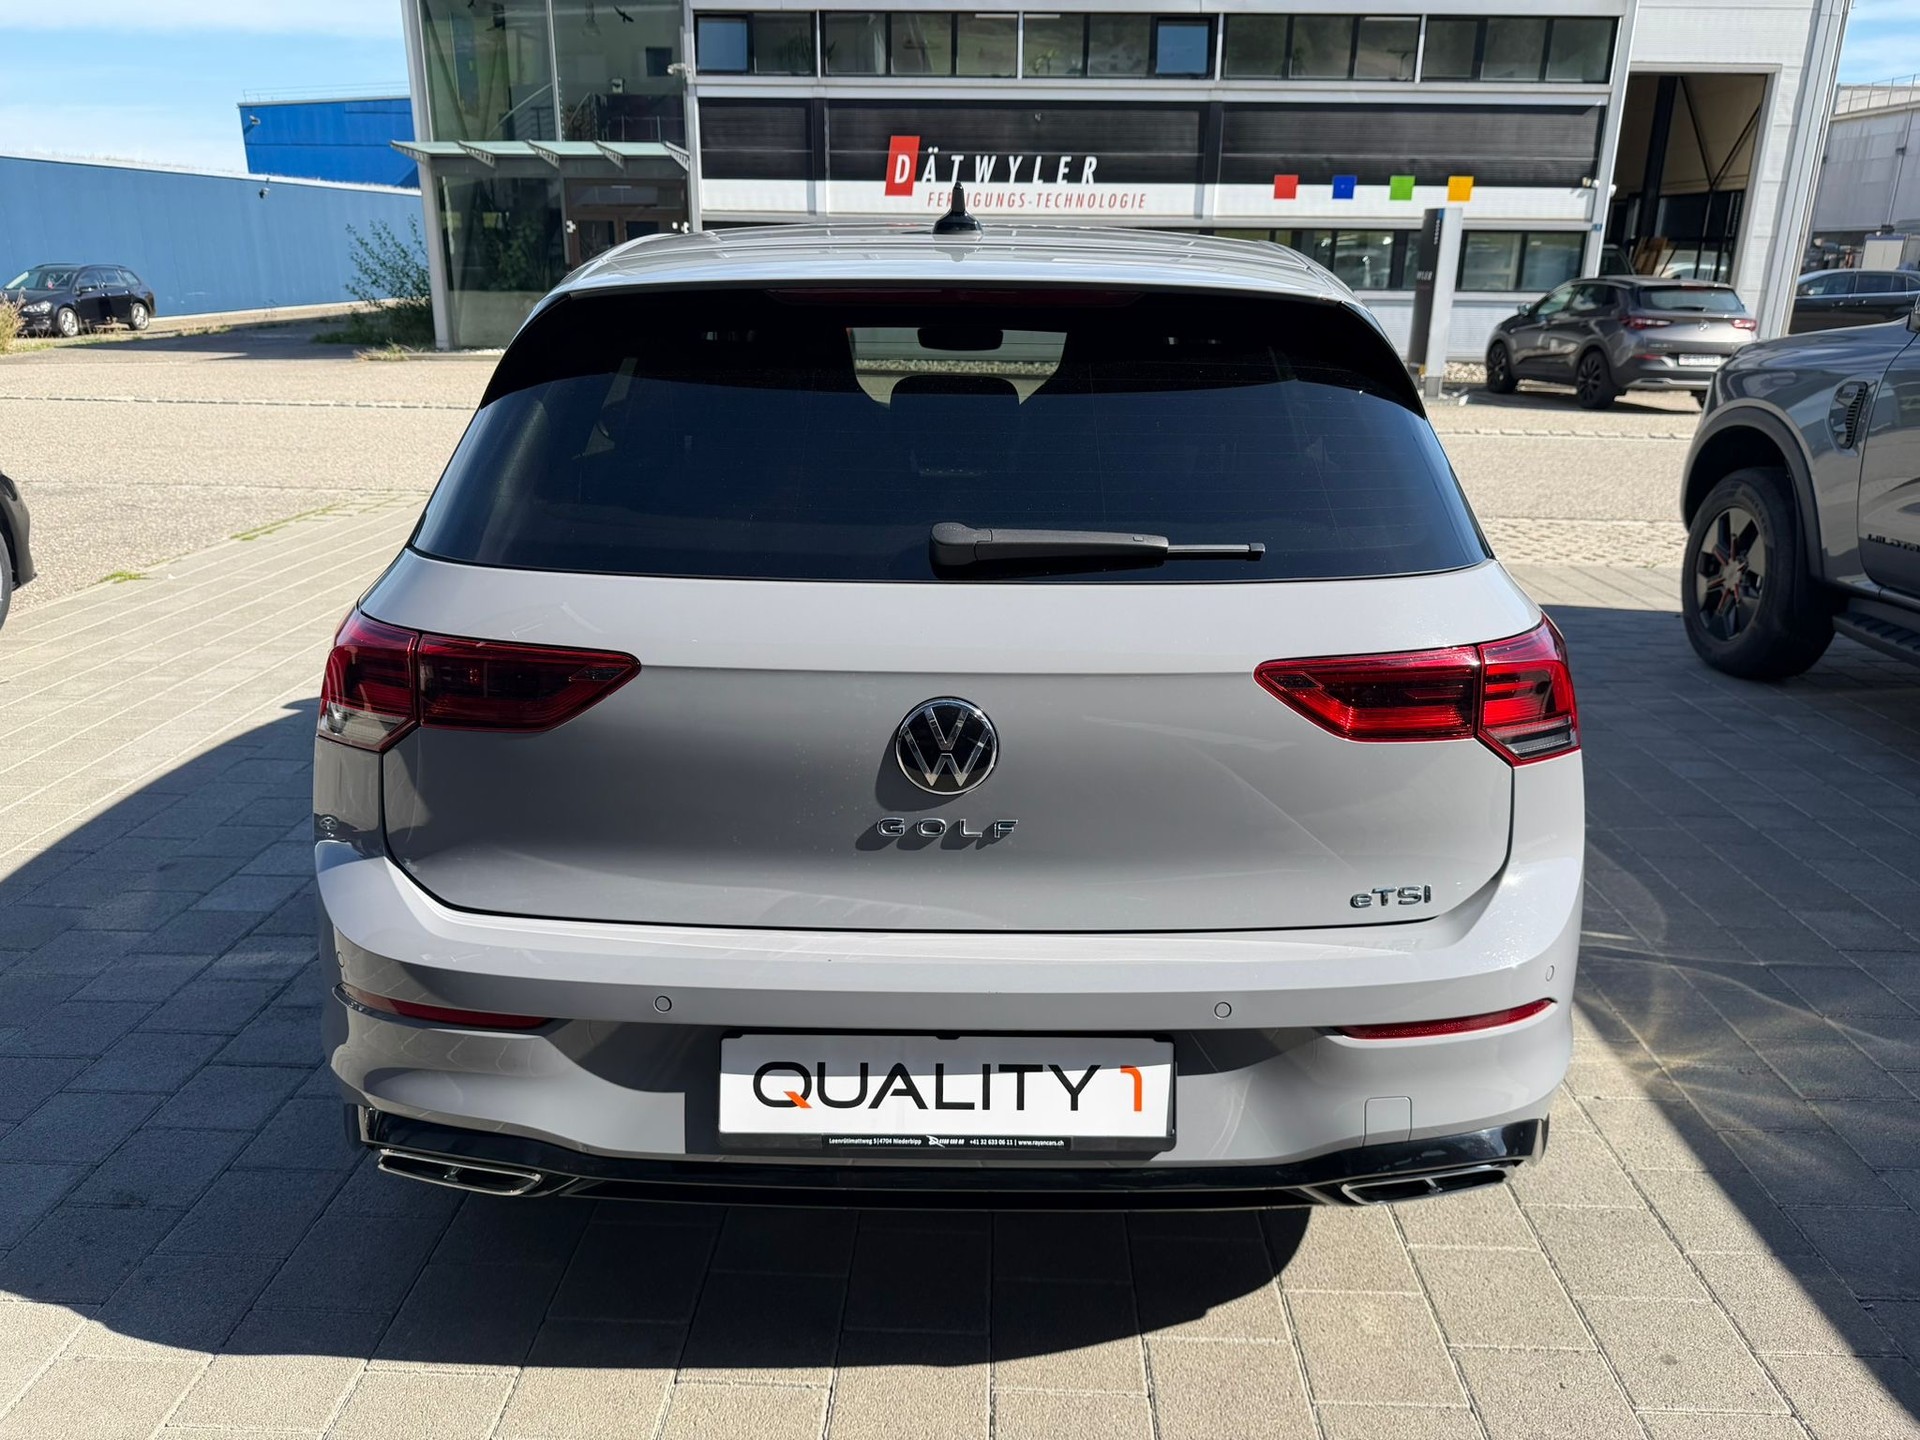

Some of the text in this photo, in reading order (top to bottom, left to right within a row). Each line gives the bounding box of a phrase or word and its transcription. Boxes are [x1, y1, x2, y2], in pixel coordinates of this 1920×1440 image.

[894, 146, 1098, 184] DÄTWYLER
[927, 191, 1147, 209] FERIGUNGS-TECHNOLOGIE
[876, 817, 1019, 838] GOLF
[1349, 884, 1432, 909] eTSI
[893, 1138, 921, 1146] Niederbipp
